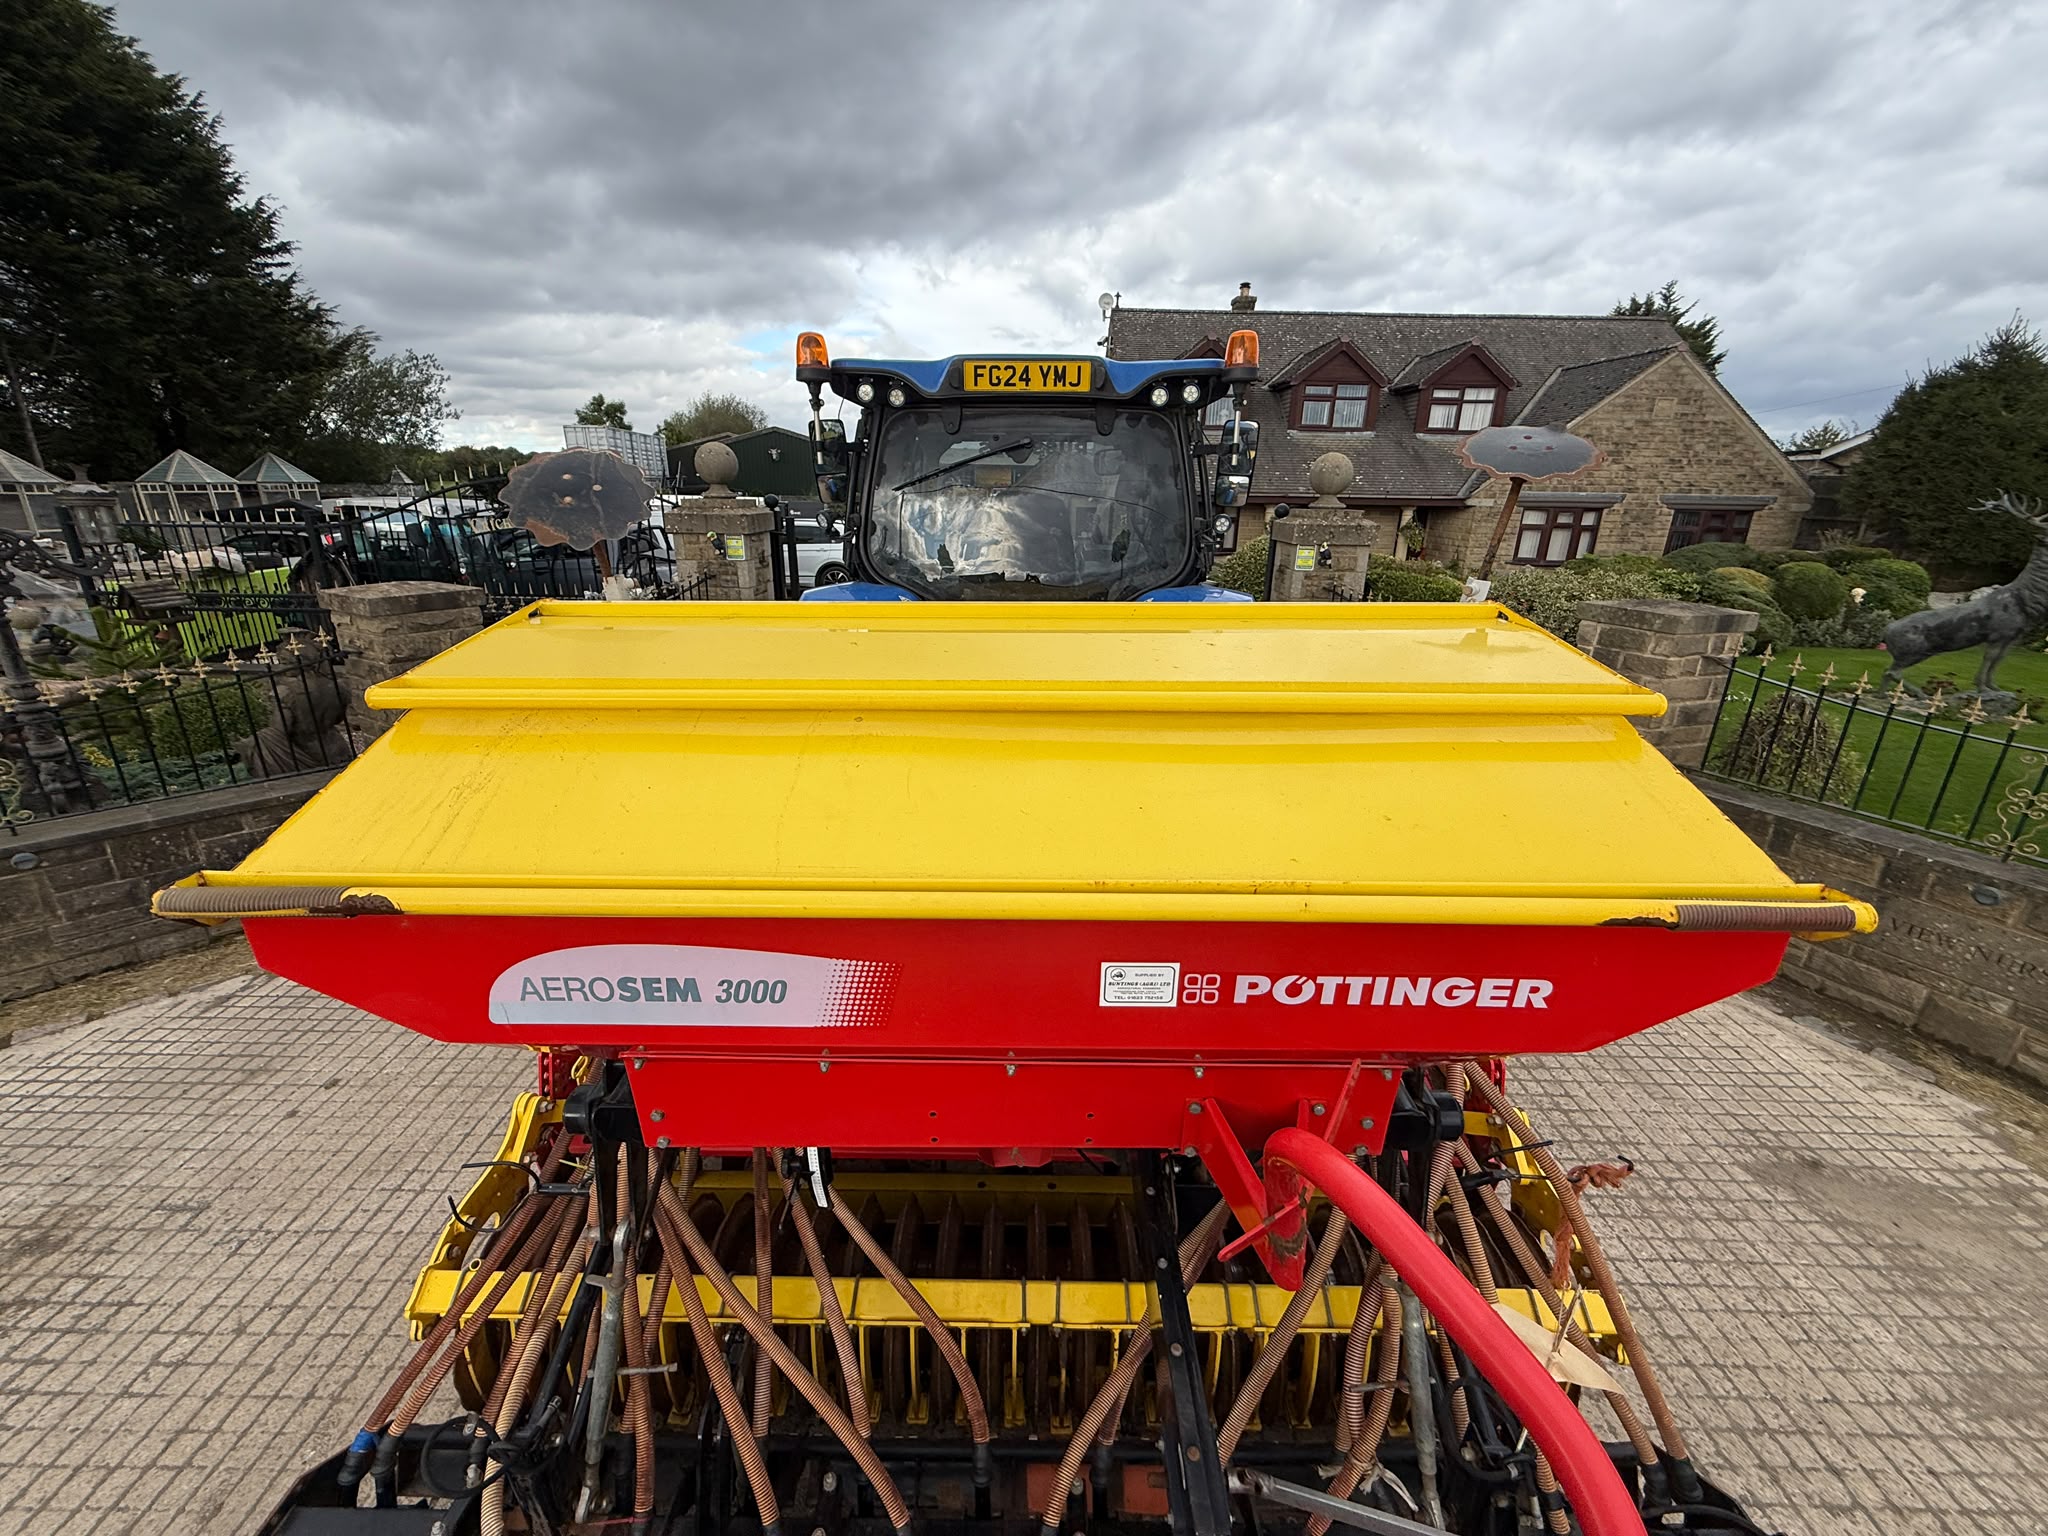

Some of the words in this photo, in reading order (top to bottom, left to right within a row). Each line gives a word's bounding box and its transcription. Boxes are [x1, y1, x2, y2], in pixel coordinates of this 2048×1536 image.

[973, 365, 1031, 387] FG24
[1039, 365, 1081, 387] YMJ
[520, 976, 702, 1003] AEROSEM
[715, 979, 788, 1004] 3000
